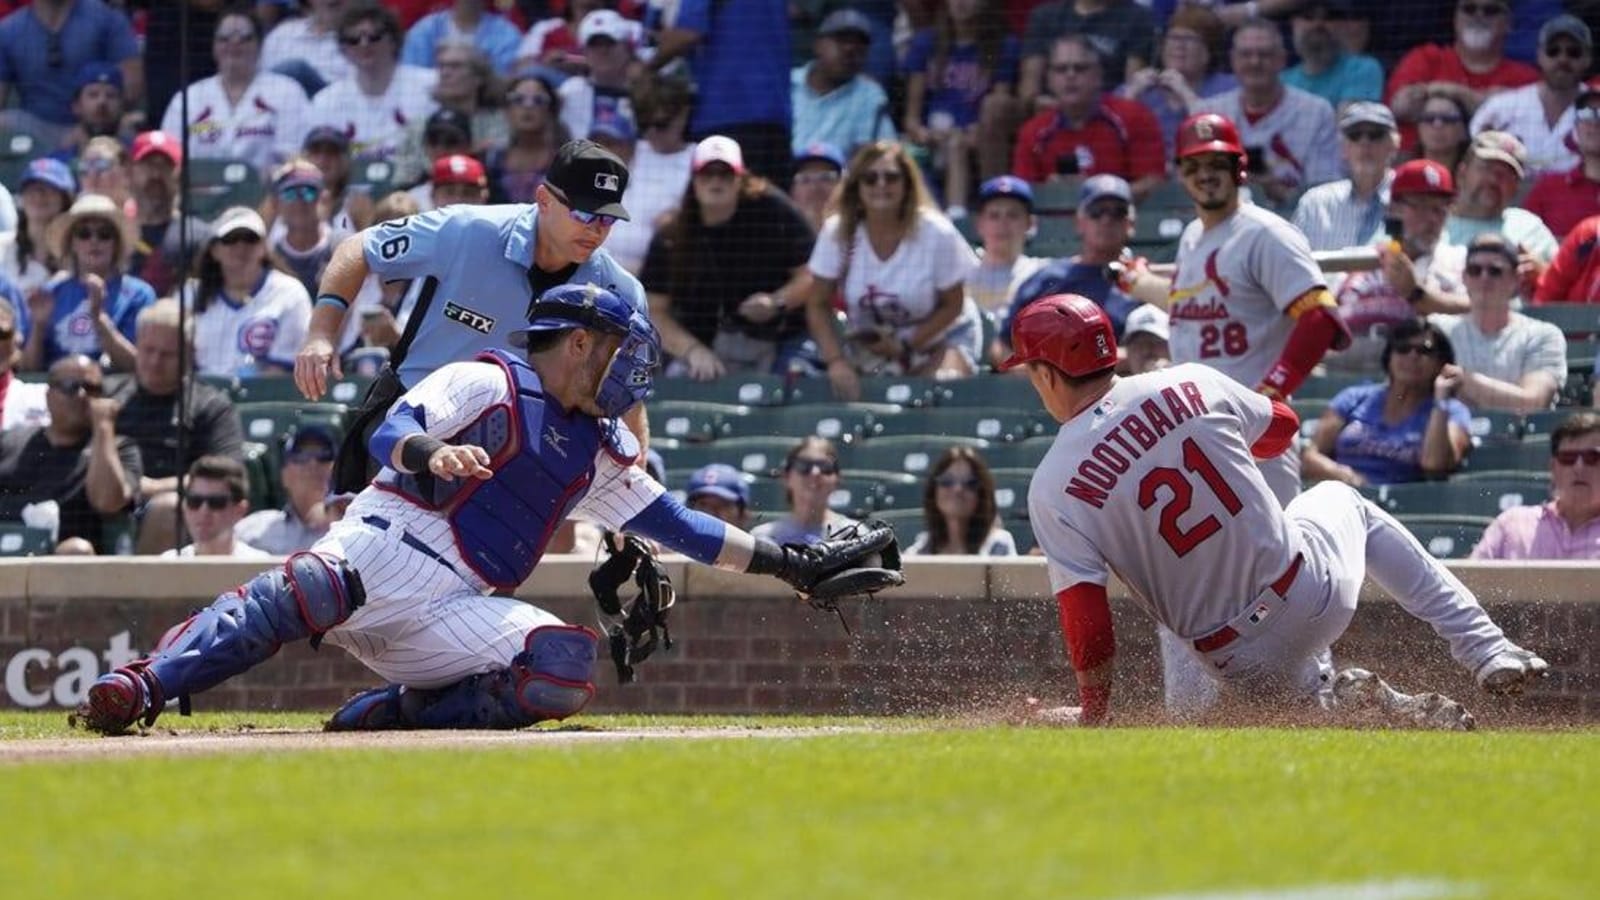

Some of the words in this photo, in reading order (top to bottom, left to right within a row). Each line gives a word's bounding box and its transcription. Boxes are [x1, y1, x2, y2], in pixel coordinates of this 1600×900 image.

[459, 311, 493, 332] FTX
[1200, 321, 1249, 358] 28
[1065, 381, 1210, 509] NOOTBAAR
[1138, 436, 1244, 559] 21
[5, 630, 181, 708] cat
